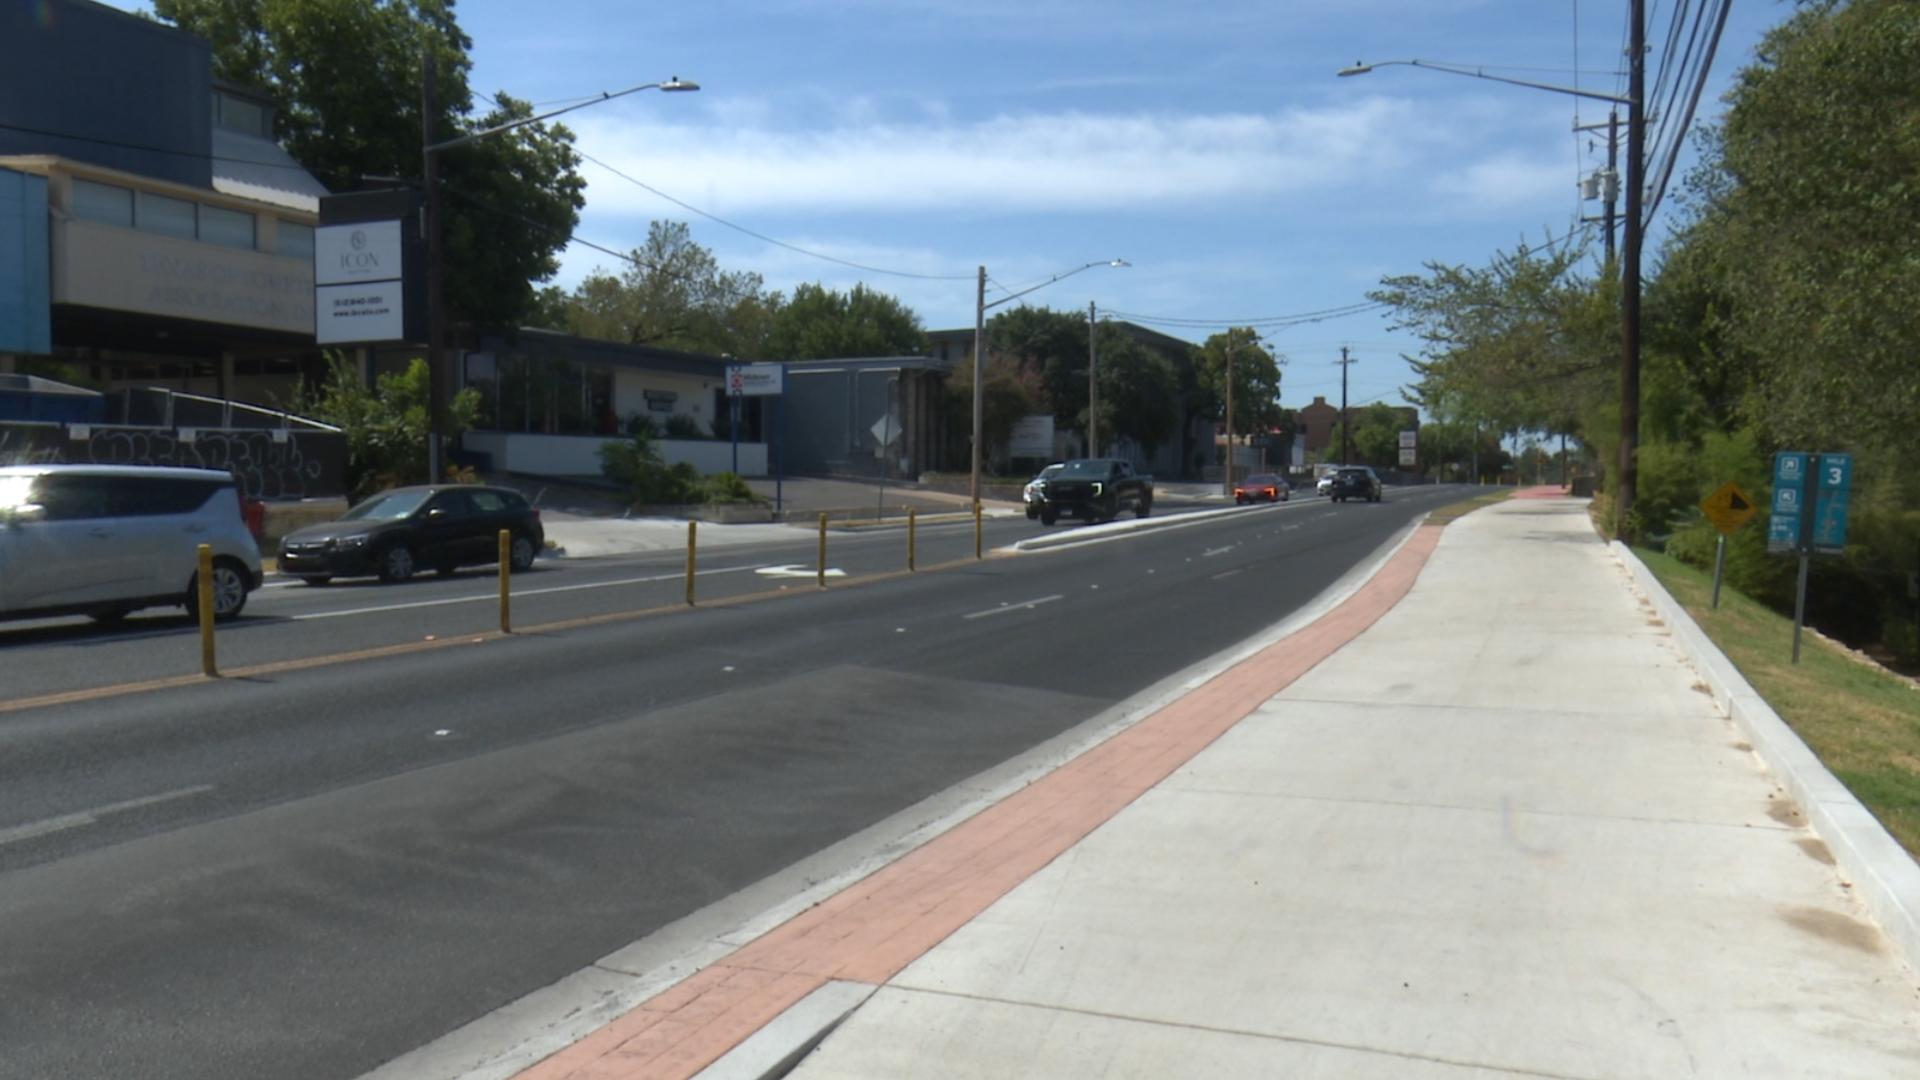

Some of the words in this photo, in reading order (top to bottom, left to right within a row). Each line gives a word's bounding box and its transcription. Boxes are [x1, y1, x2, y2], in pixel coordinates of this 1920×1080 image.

[340, 252, 380, 269] ICON
[1826, 457, 1845, 465] MILE
[1828, 467, 1842, 485] 3
